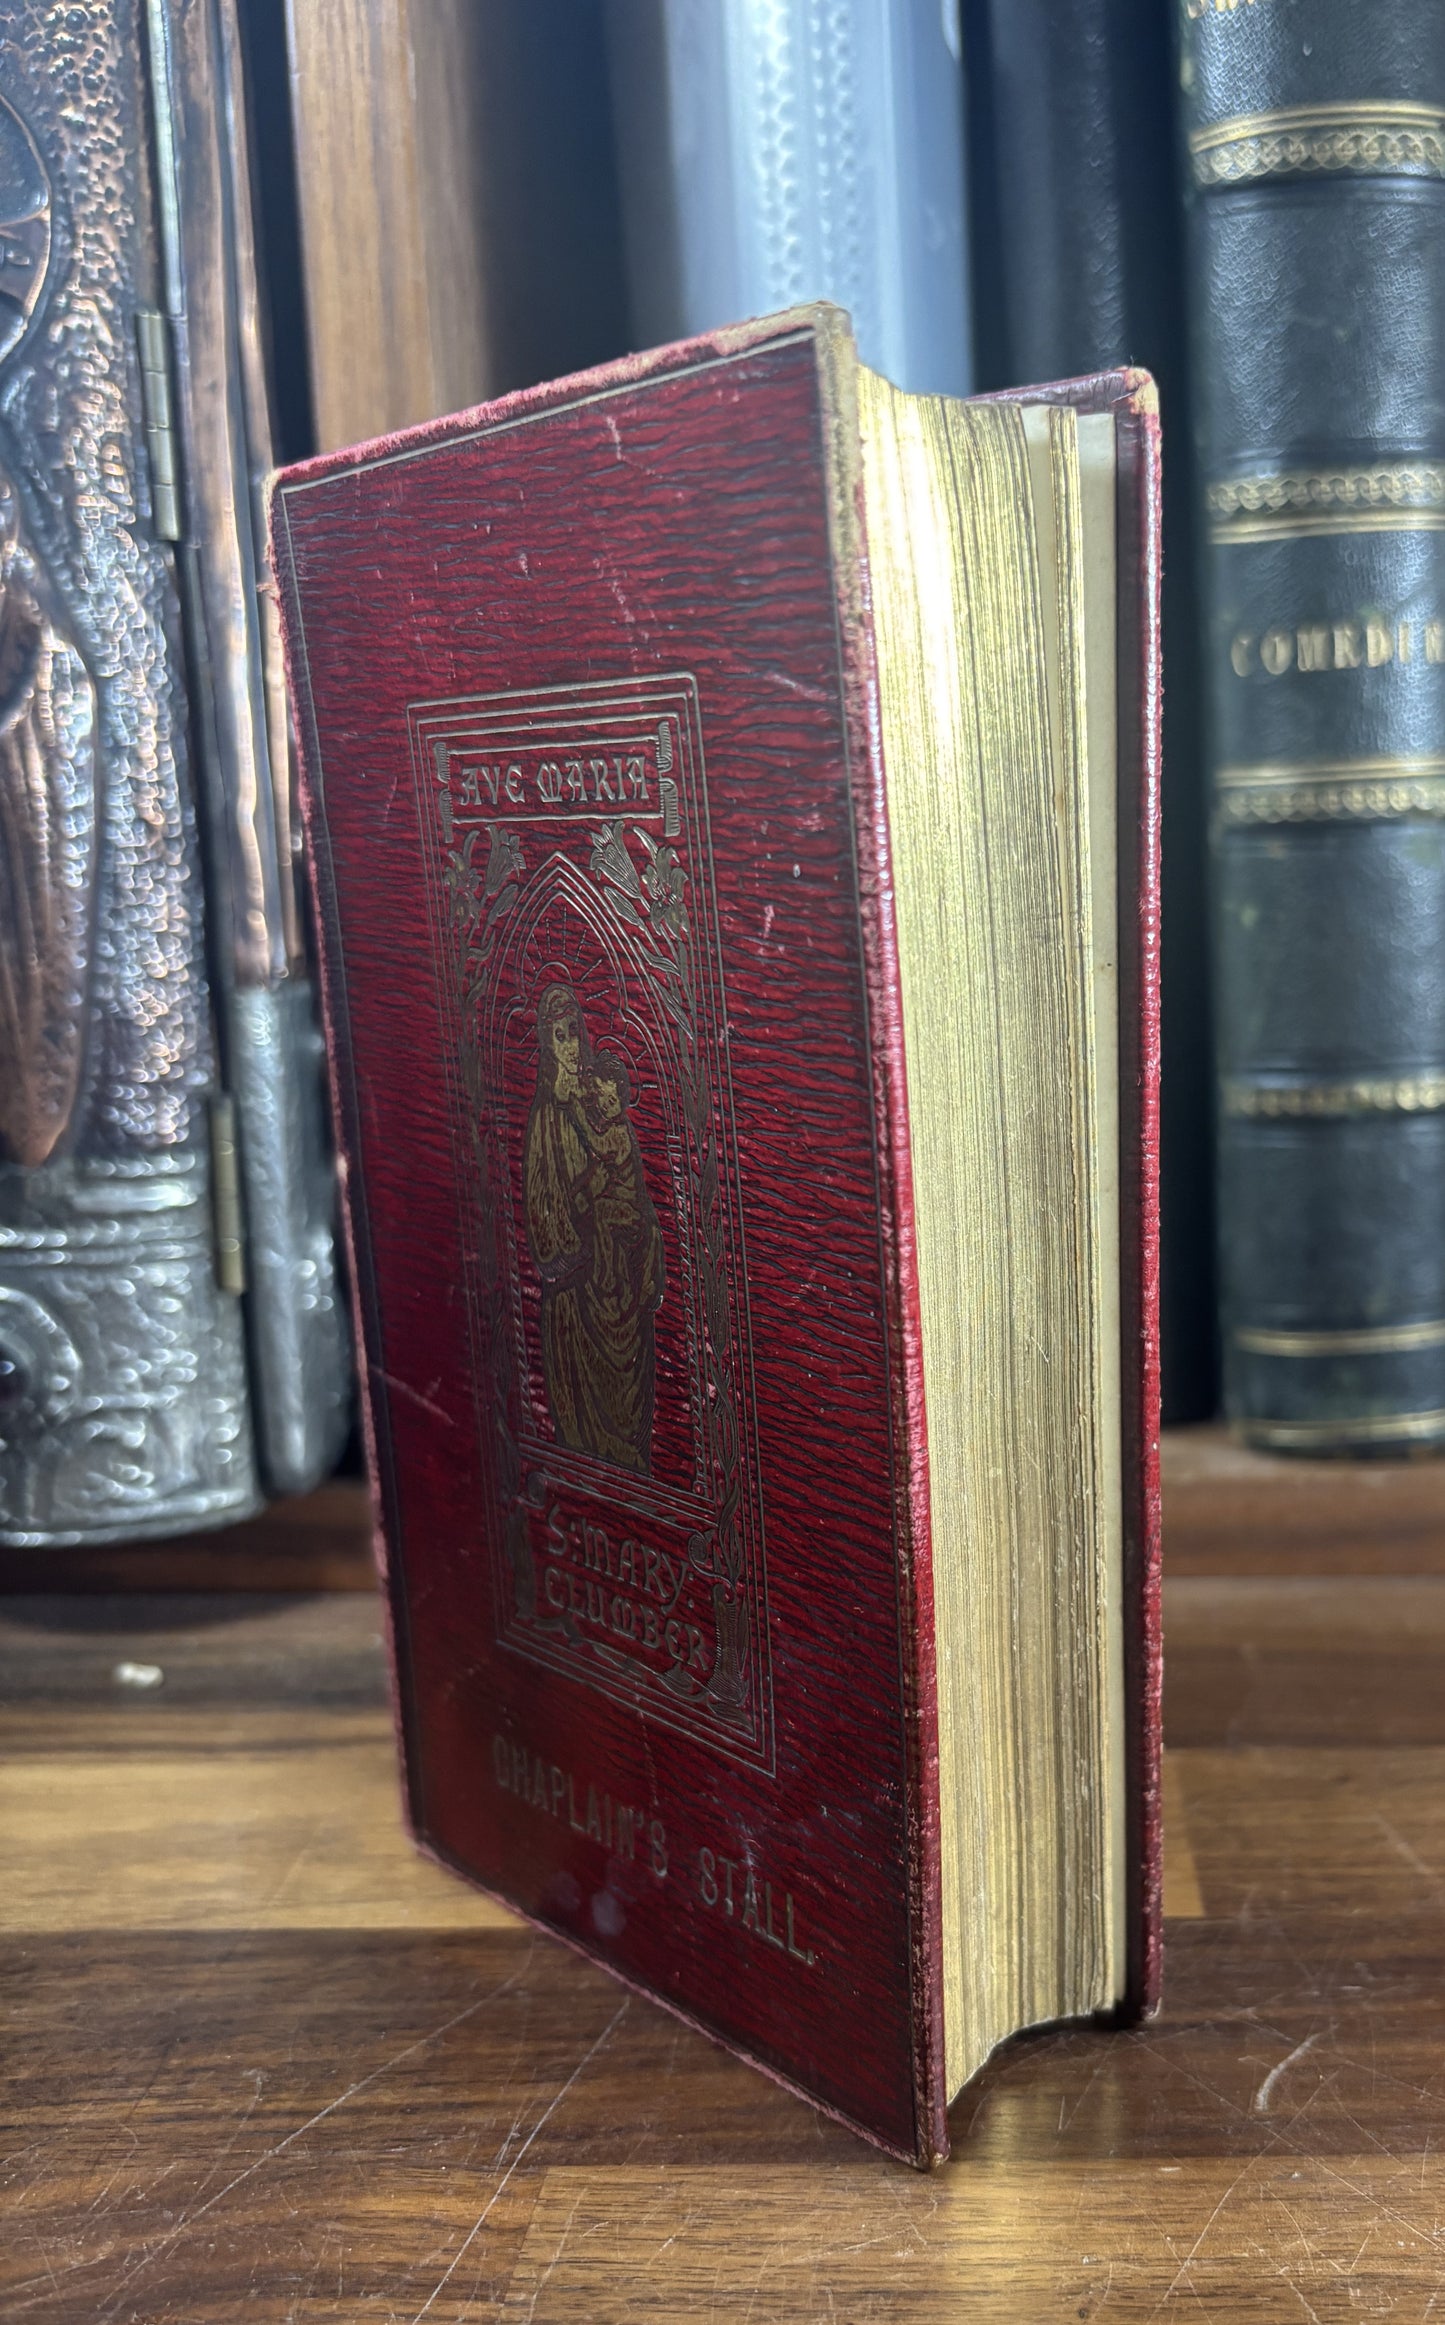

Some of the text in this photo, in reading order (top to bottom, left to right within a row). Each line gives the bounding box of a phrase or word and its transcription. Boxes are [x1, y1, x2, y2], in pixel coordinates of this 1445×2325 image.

[459, 755, 651, 806] AVE MARIA
[544, 1566, 710, 1672] CLUMBER
